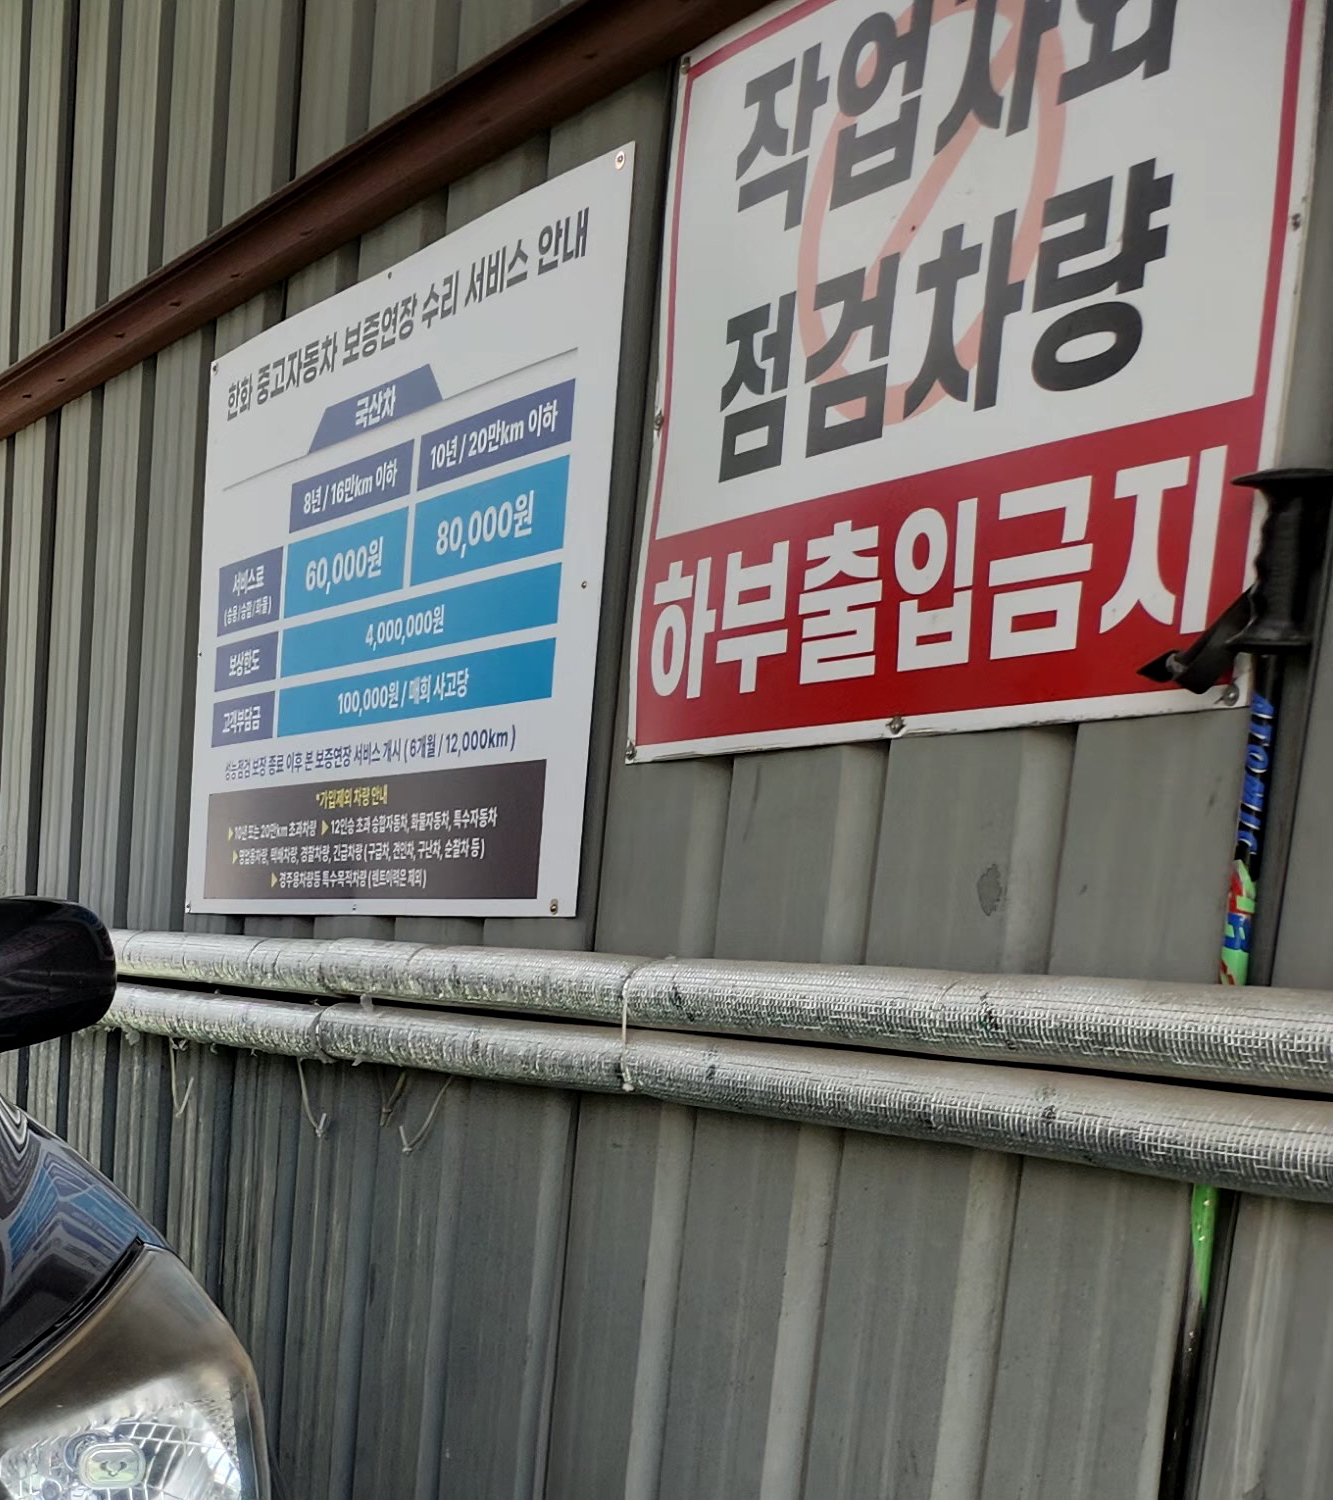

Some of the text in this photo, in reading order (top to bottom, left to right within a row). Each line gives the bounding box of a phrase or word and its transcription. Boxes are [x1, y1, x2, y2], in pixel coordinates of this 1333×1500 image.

[227, 206, 590, 421] 한화 중고자동차 보증연장 수리 서비스 안내
[719, 157, 1175, 482] 점검차량
[354, 386, 396, 428] 국산차
[430, 434, 458, 471] 10년
[468, 418, 524, 458] 20만km
[528, 398, 559, 437] 이하
[303, 483, 322, 515] 8년
[330, 471, 374, 505] 16만km
[375, 458, 398, 492] 이하
[435, 489, 535, 559] 80,000원
[304, 535, 384, 595] 60,000원
[650, 445, 1229, 700] 하부출입금지
[365, 604, 446, 651] 4,000,000원
[337, 681, 399, 717] 100,000원
[433, 668, 470, 698] 사고당
[286, 751, 303, 773] 이후
[305, 751, 314, 771] 본
[315, 745, 352, 770] 보증연장
[353, 741, 381, 766] 서비스
[383, 737, 402, 763] 개시
[371, 784, 389, 806] 안내
